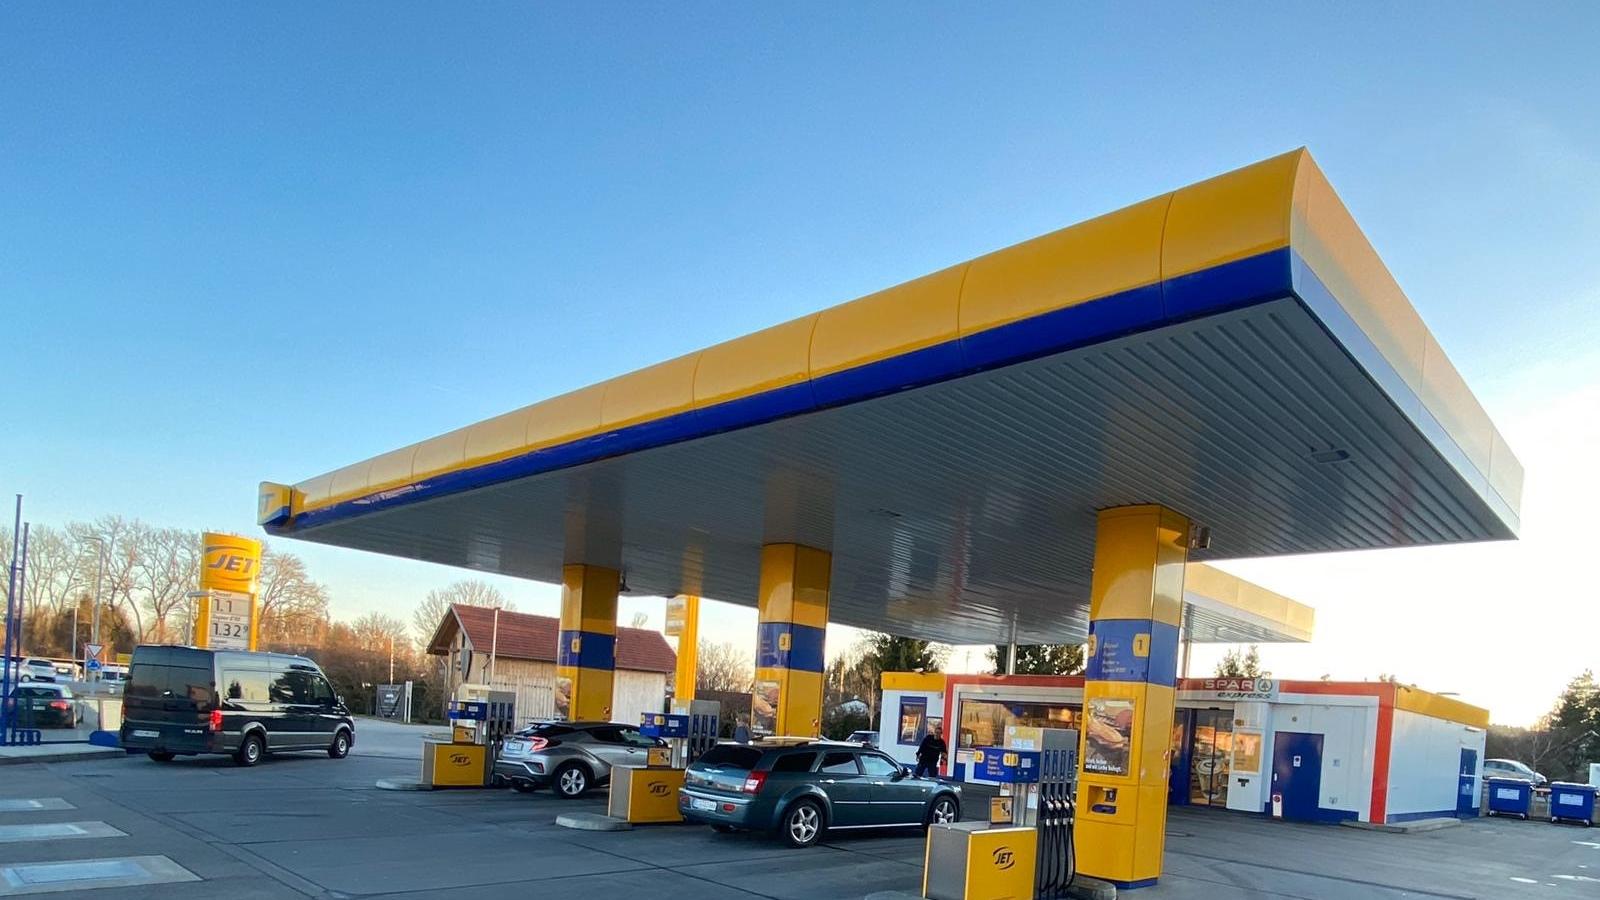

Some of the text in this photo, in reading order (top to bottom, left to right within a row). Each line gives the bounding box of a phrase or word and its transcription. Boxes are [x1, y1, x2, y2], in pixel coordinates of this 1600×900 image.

[207, 554, 255, 573] JET
[1205, 679, 1253, 690] SPAR
[1217, 691, 1272, 699] express
[650, 785, 668, 793] JET
[995, 852, 1013, 865] JET
